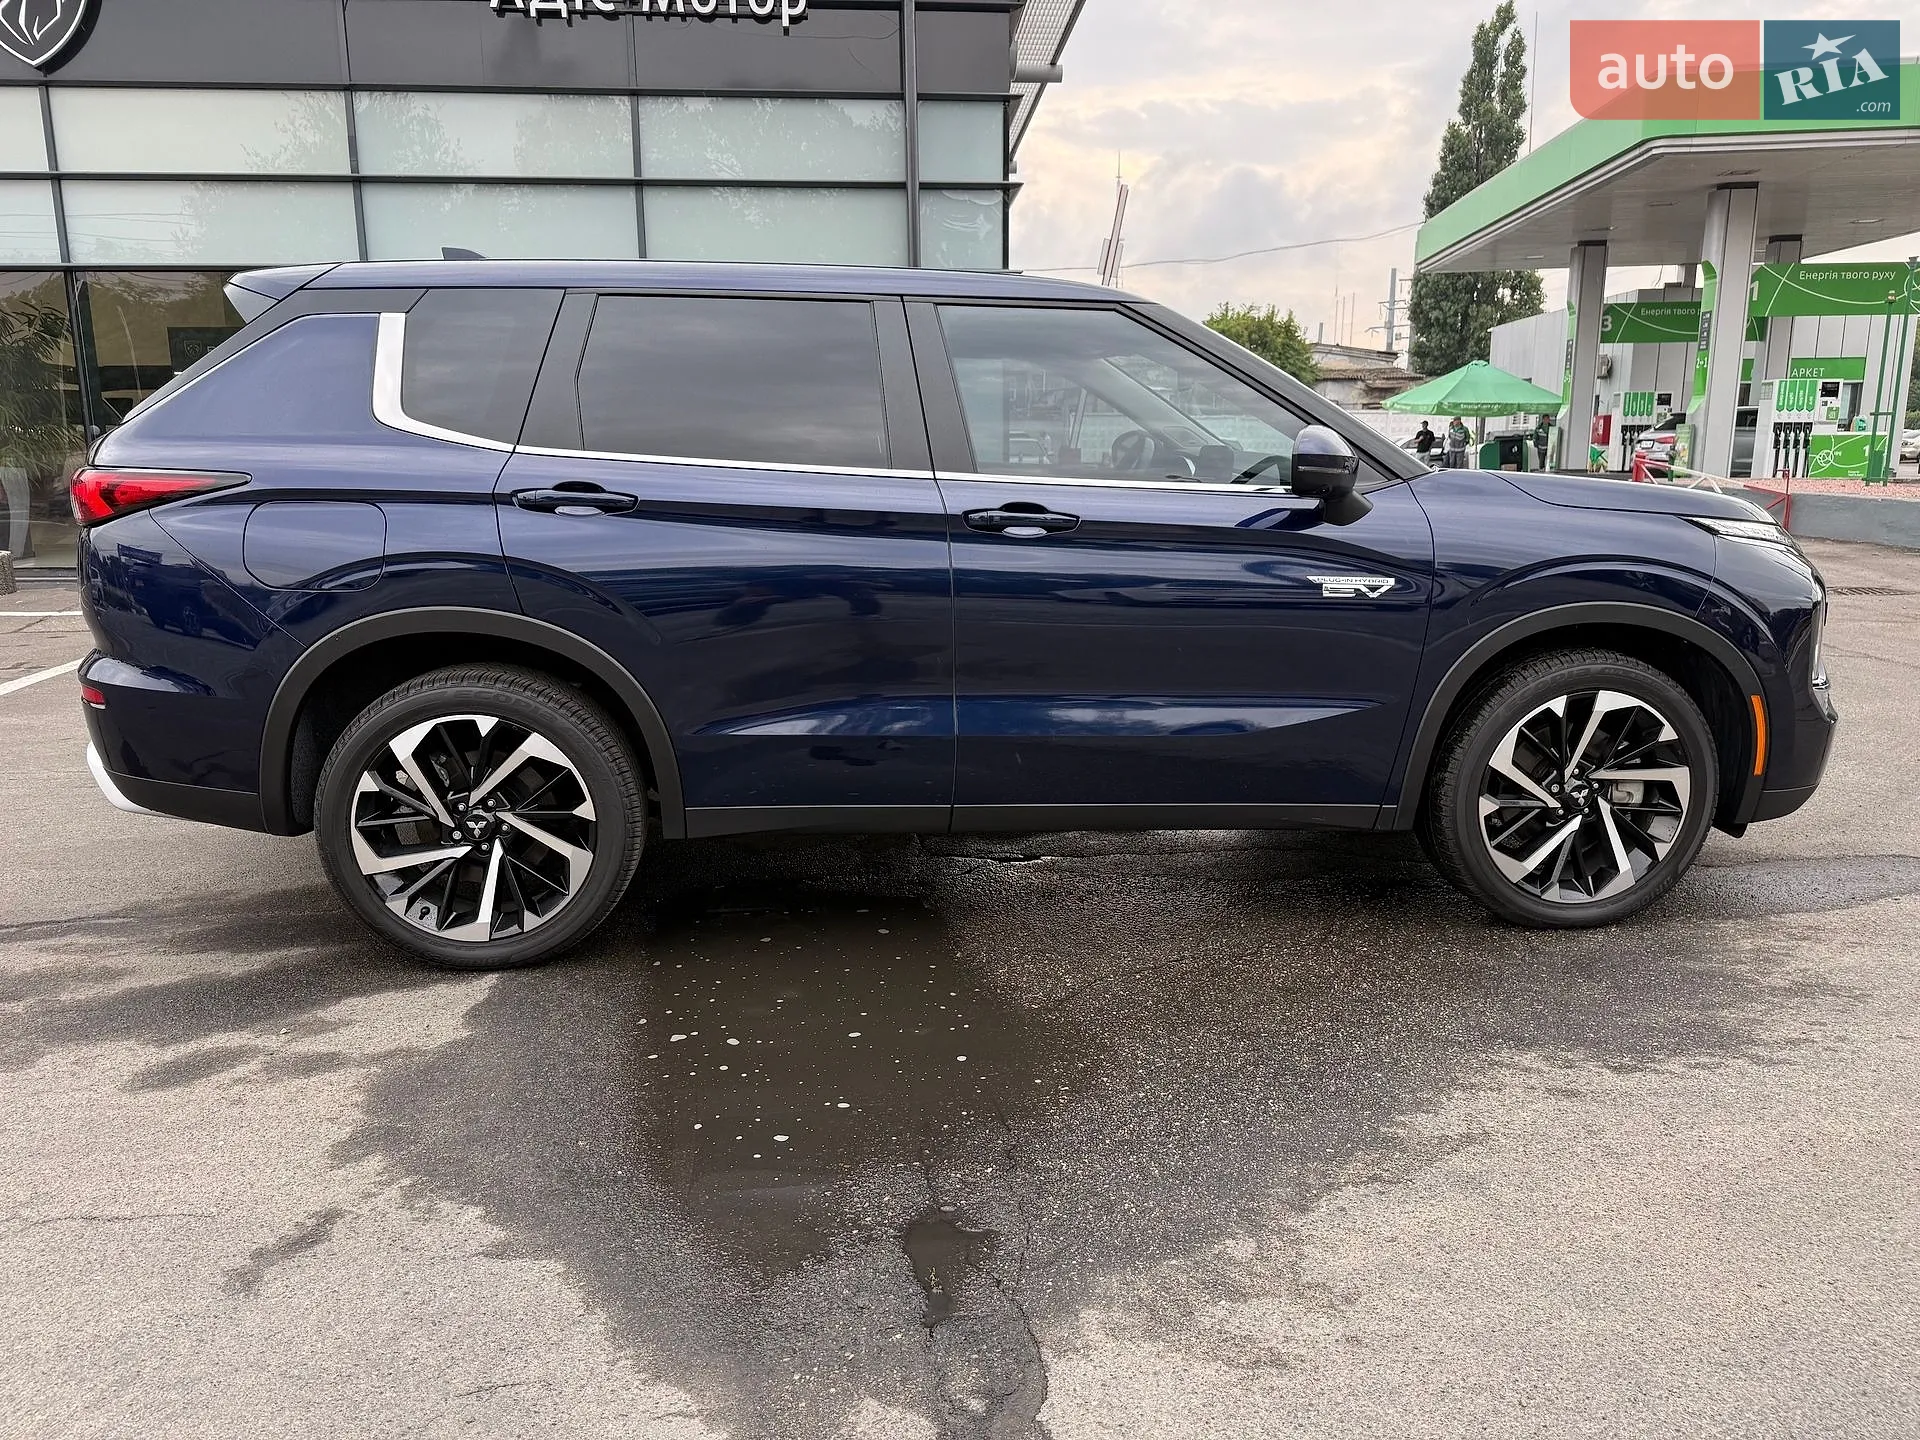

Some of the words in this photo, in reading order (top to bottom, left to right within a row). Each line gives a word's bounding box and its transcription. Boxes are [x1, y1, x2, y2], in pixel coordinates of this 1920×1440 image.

[1799, 270, 1838, 281] Енергія
[1841, 272, 1870, 280] твого
[1872, 271, 1896, 281] руху
[1640, 307, 1672, 317] Енергія
[1601, 315, 1612, 332] 3
[1322, 583, 1393, 599] EV
